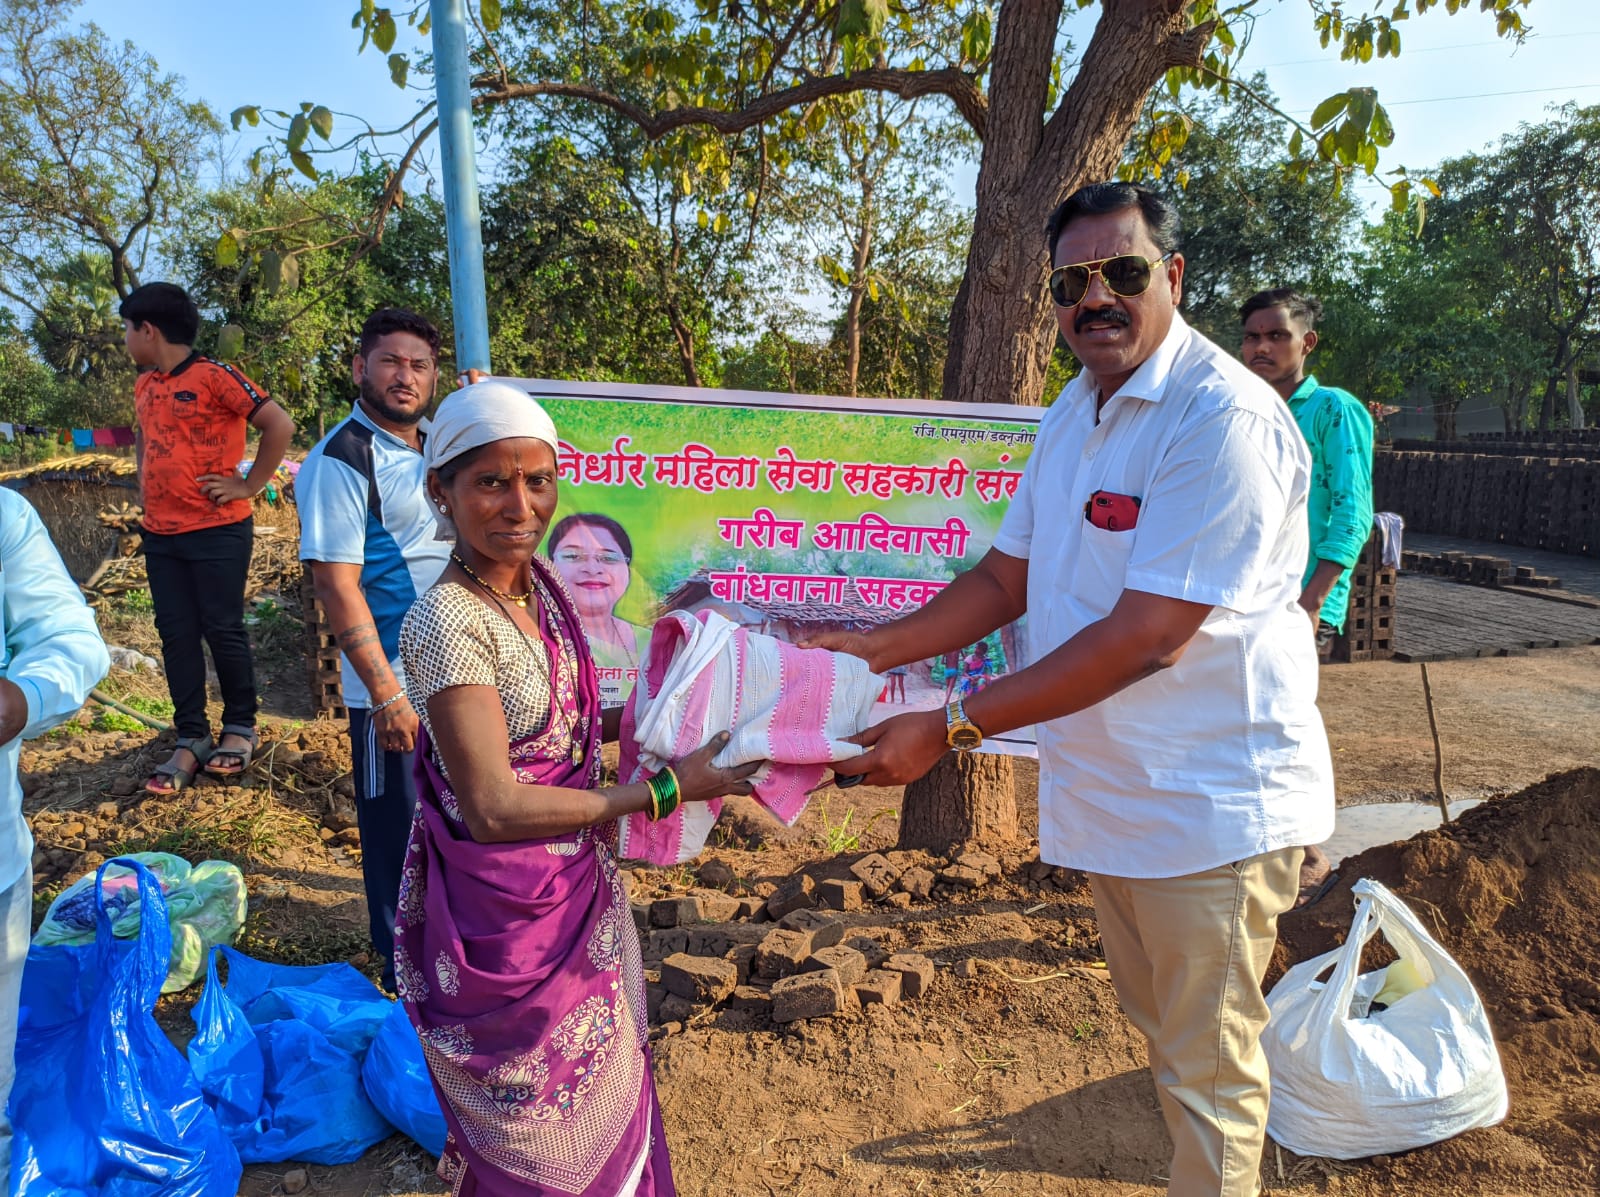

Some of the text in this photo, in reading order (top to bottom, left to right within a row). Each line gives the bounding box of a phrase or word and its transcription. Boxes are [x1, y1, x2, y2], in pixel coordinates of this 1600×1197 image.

[654, 444, 761, 492] महिला
[767, 447, 836, 492] सेवा
[843, 458, 969, 499] सहकारी
[718, 508, 971, 558] गरीब आदिवासी
[709, 565, 951, 610] बांधवाना सहक
